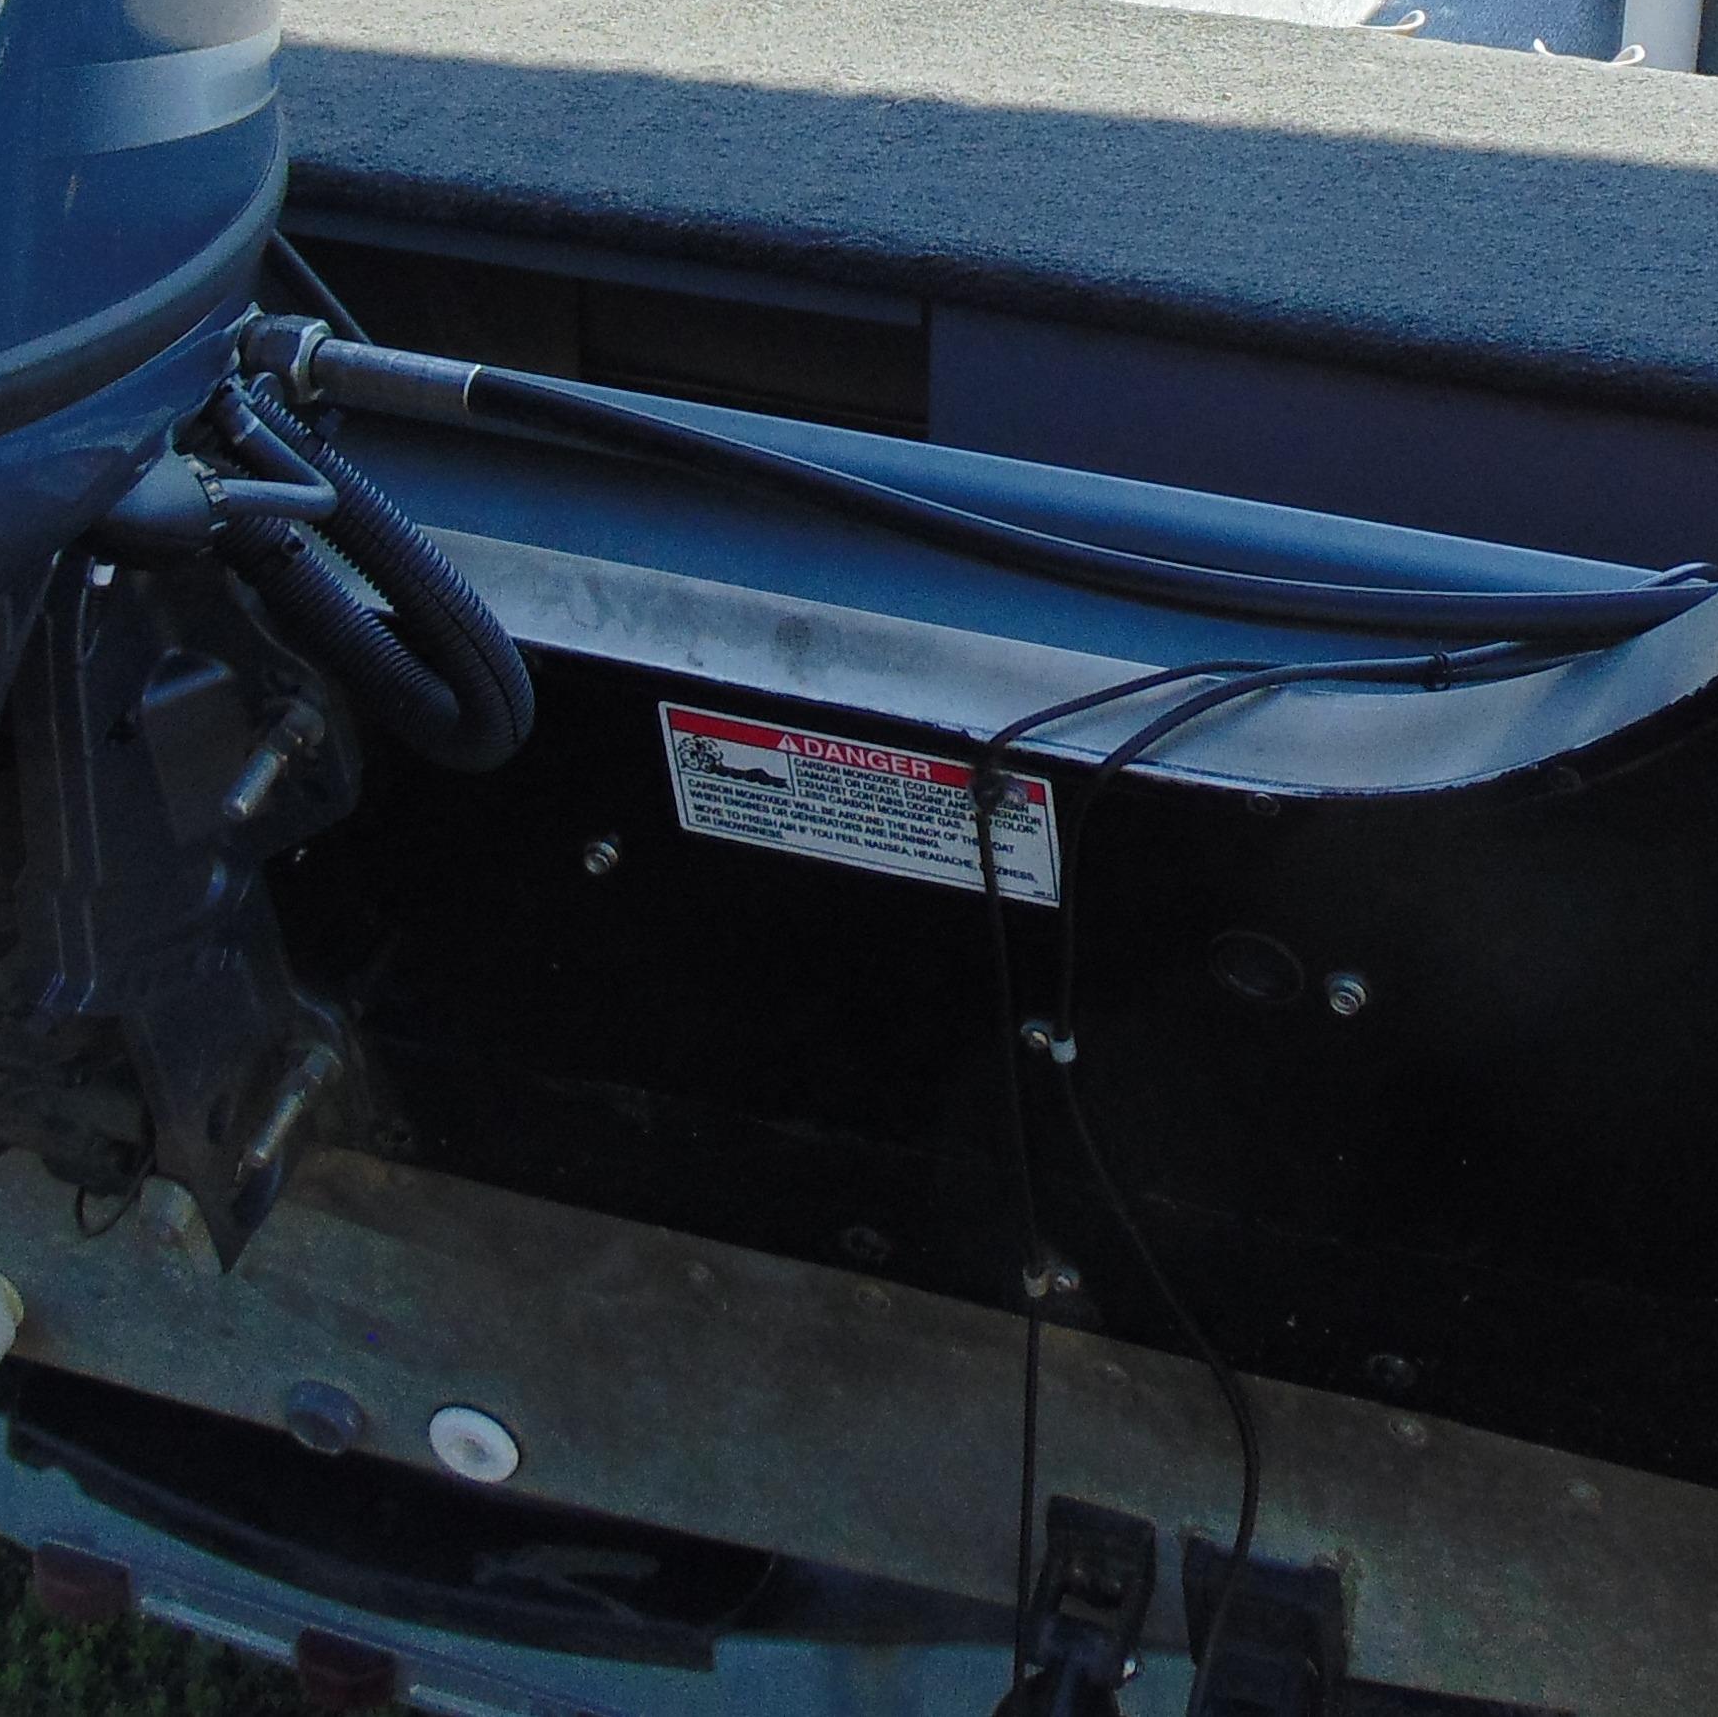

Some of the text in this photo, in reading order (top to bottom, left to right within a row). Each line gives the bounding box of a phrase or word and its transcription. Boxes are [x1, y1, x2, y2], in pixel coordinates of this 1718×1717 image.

[792, 757, 840, 775] CARBON
[841, 767, 901, 787] MONOXIDE
[902, 779, 926, 796] (CO)
[927, 784, 952, 797] CAN
[802, 736, 931, 780] DANGER
[794, 768, 842, 785] DAMAGE
[844, 778, 860, 789] OR
[904, 790, 945, 806] ENGINE
[796, 777, 846, 796] EXHAUST
[849, 788, 904, 807] CONTAINS
[906, 800, 966, 820] ODORLESS
[798, 788, 826, 801] LESS
[828, 794, 875, 811] CARBON
[876, 804, 934, 824] MONOXIDE
[687, 778, 733, 795] CARBON
[734, 787, 791, 807] MONOXIDE
[792, 799, 821, 813] WILL
[820, 805, 836, 816] BE
[837, 809, 884, 826] AROUND
[886, 819, 907, 831] THE
[909, 823, 941, 838] BACK
[943, 830, 957, 841] OF
[689, 788, 721, 803] WHEN
[723, 795, 769, 813] ENGINES
[770, 805, 787, 817] OR
[789, 809, 862, 832] GENERATORS
[863, 824, 887, 837] ARE
[692, 802, 724, 817] MOVE
[725, 809, 740, 820] TO
[741, 812, 777, 828] FRESH
[777, 820, 796, 832] AIR
[810, 826, 833, 839] YOU
[694, 813, 711, 824] OR
